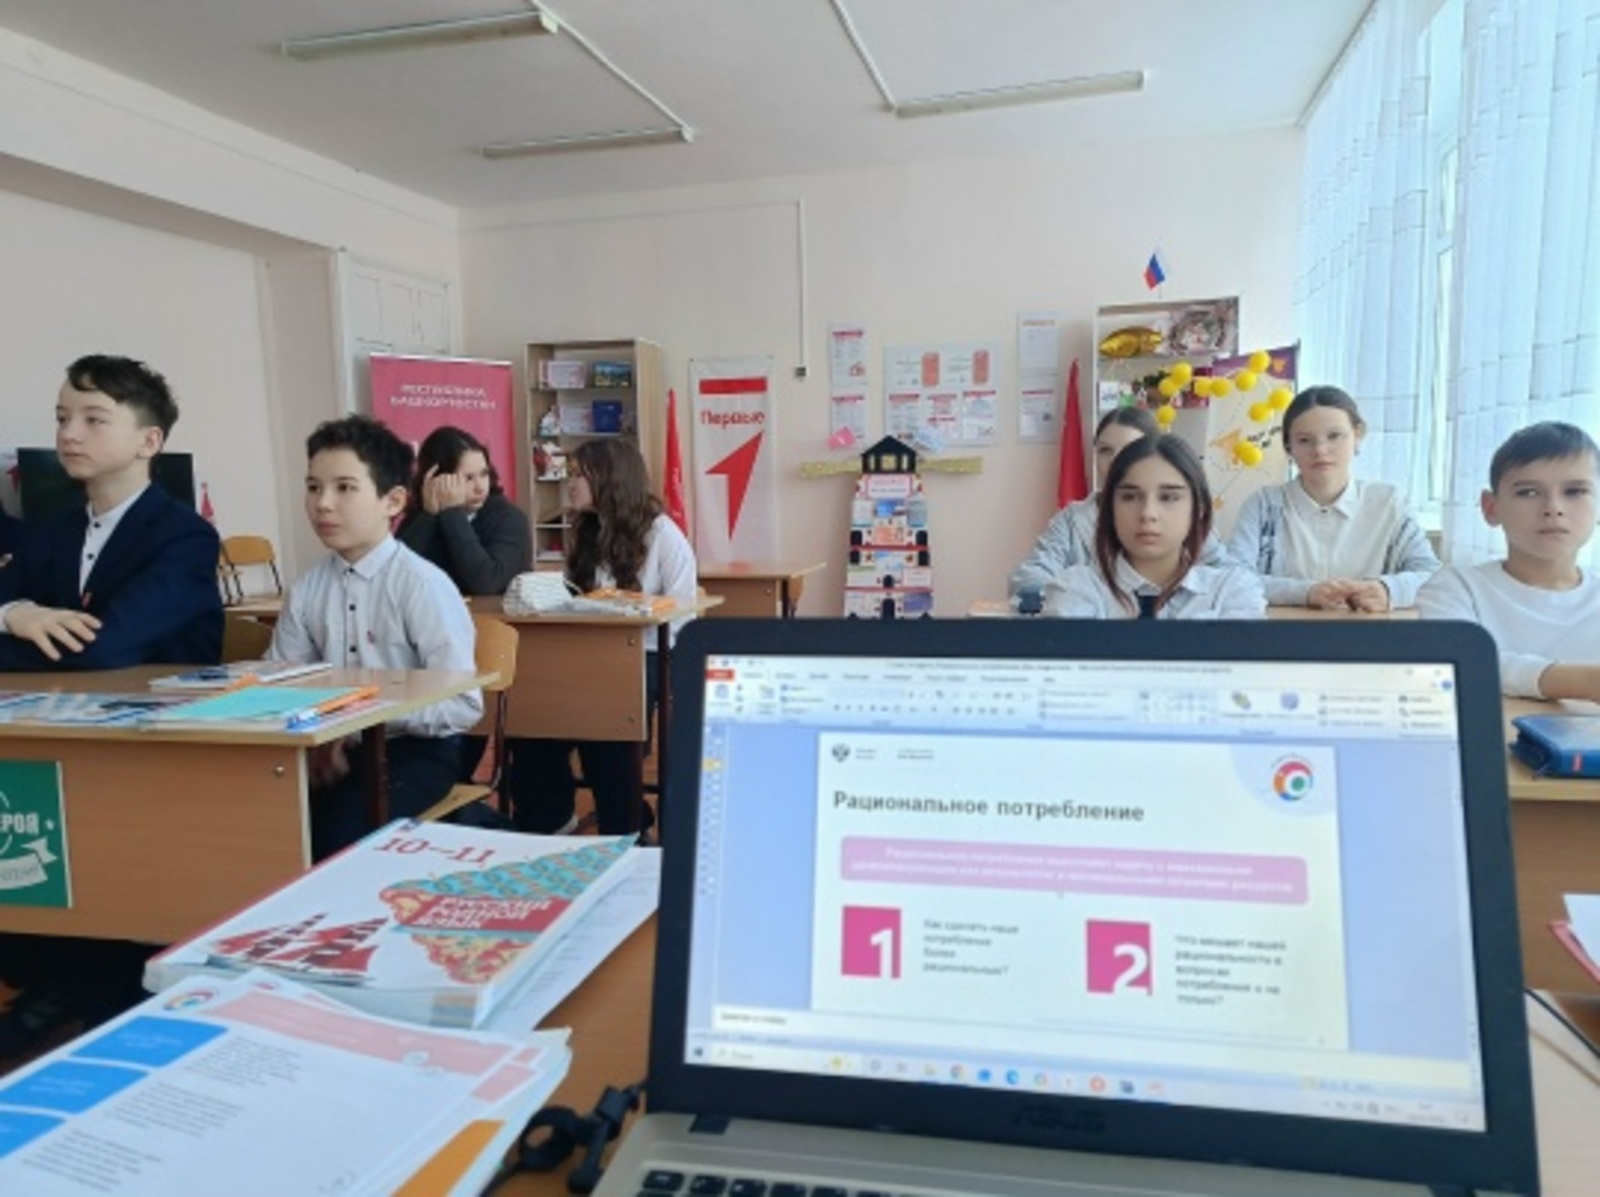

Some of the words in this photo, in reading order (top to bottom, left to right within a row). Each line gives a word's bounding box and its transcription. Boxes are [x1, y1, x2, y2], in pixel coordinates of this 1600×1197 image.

[700, 410, 765, 430] Первые
[833, 790, 988, 815] Рациональное
[997, 799, 1144, 822] потребление
[870, 927, 893, 978] 1
[923, 933, 992, 947] потребление
[923, 946, 956, 959] более
[1112, 942, 1150, 994] 2
